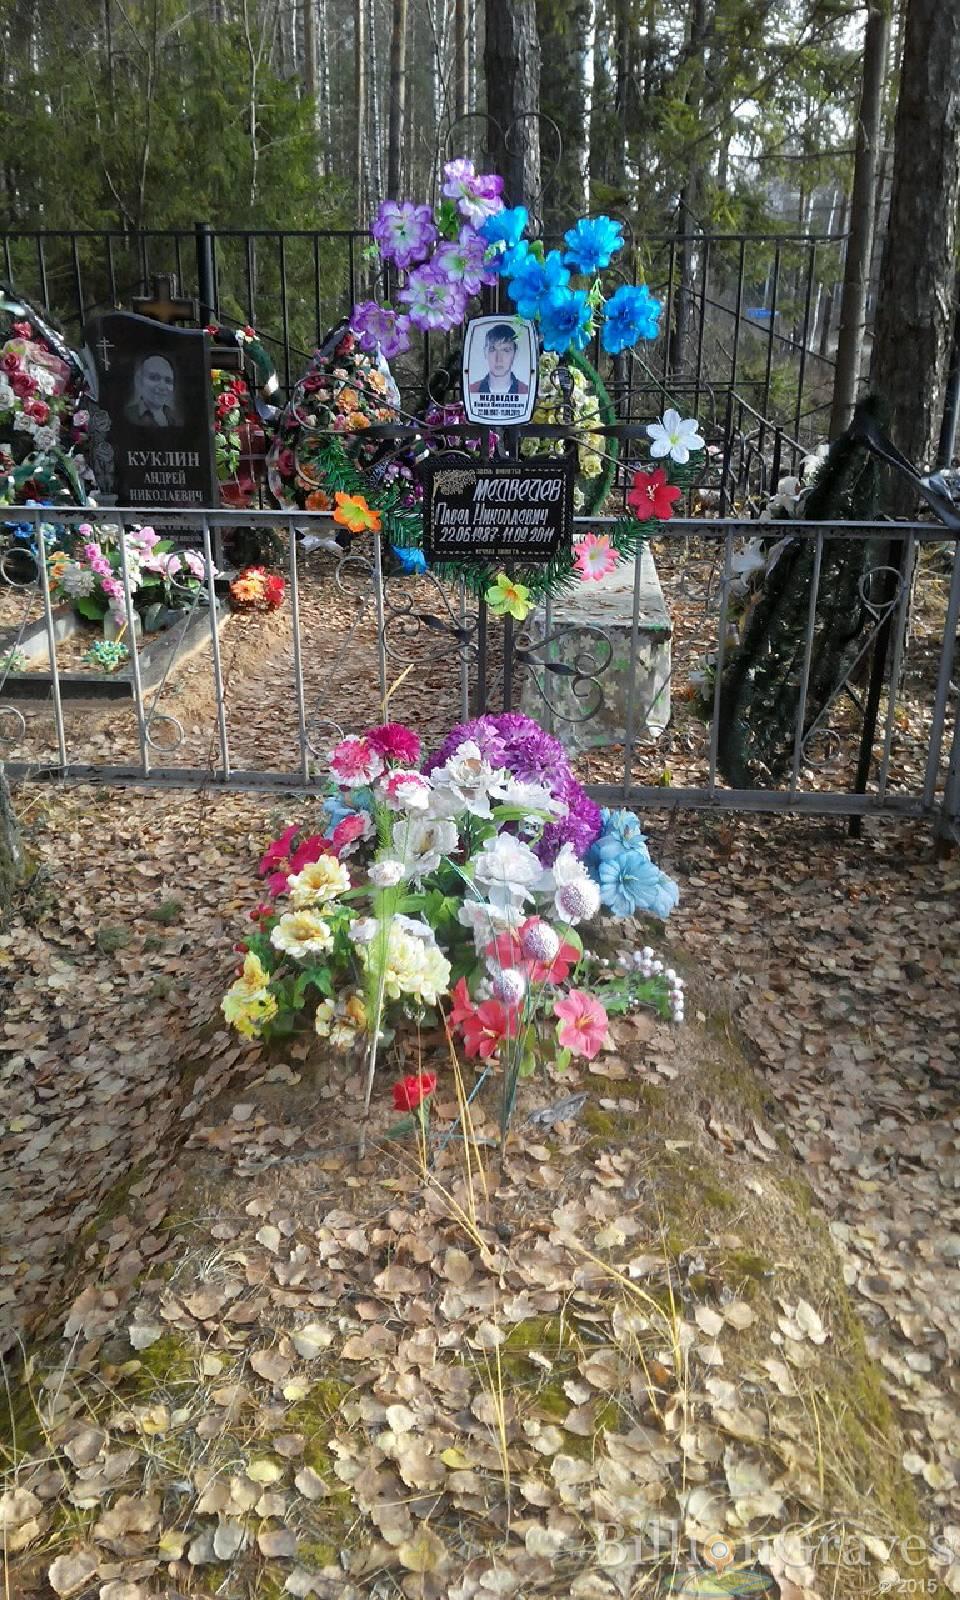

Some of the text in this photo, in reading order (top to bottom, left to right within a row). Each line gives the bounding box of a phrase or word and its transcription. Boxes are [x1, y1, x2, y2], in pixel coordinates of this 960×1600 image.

[128, 451, 200, 467] КУКЛИН
[144, 470, 186, 485] АНДРЕЙ
[130, 489, 204, 502] НИКОЛАЕВИЧ
